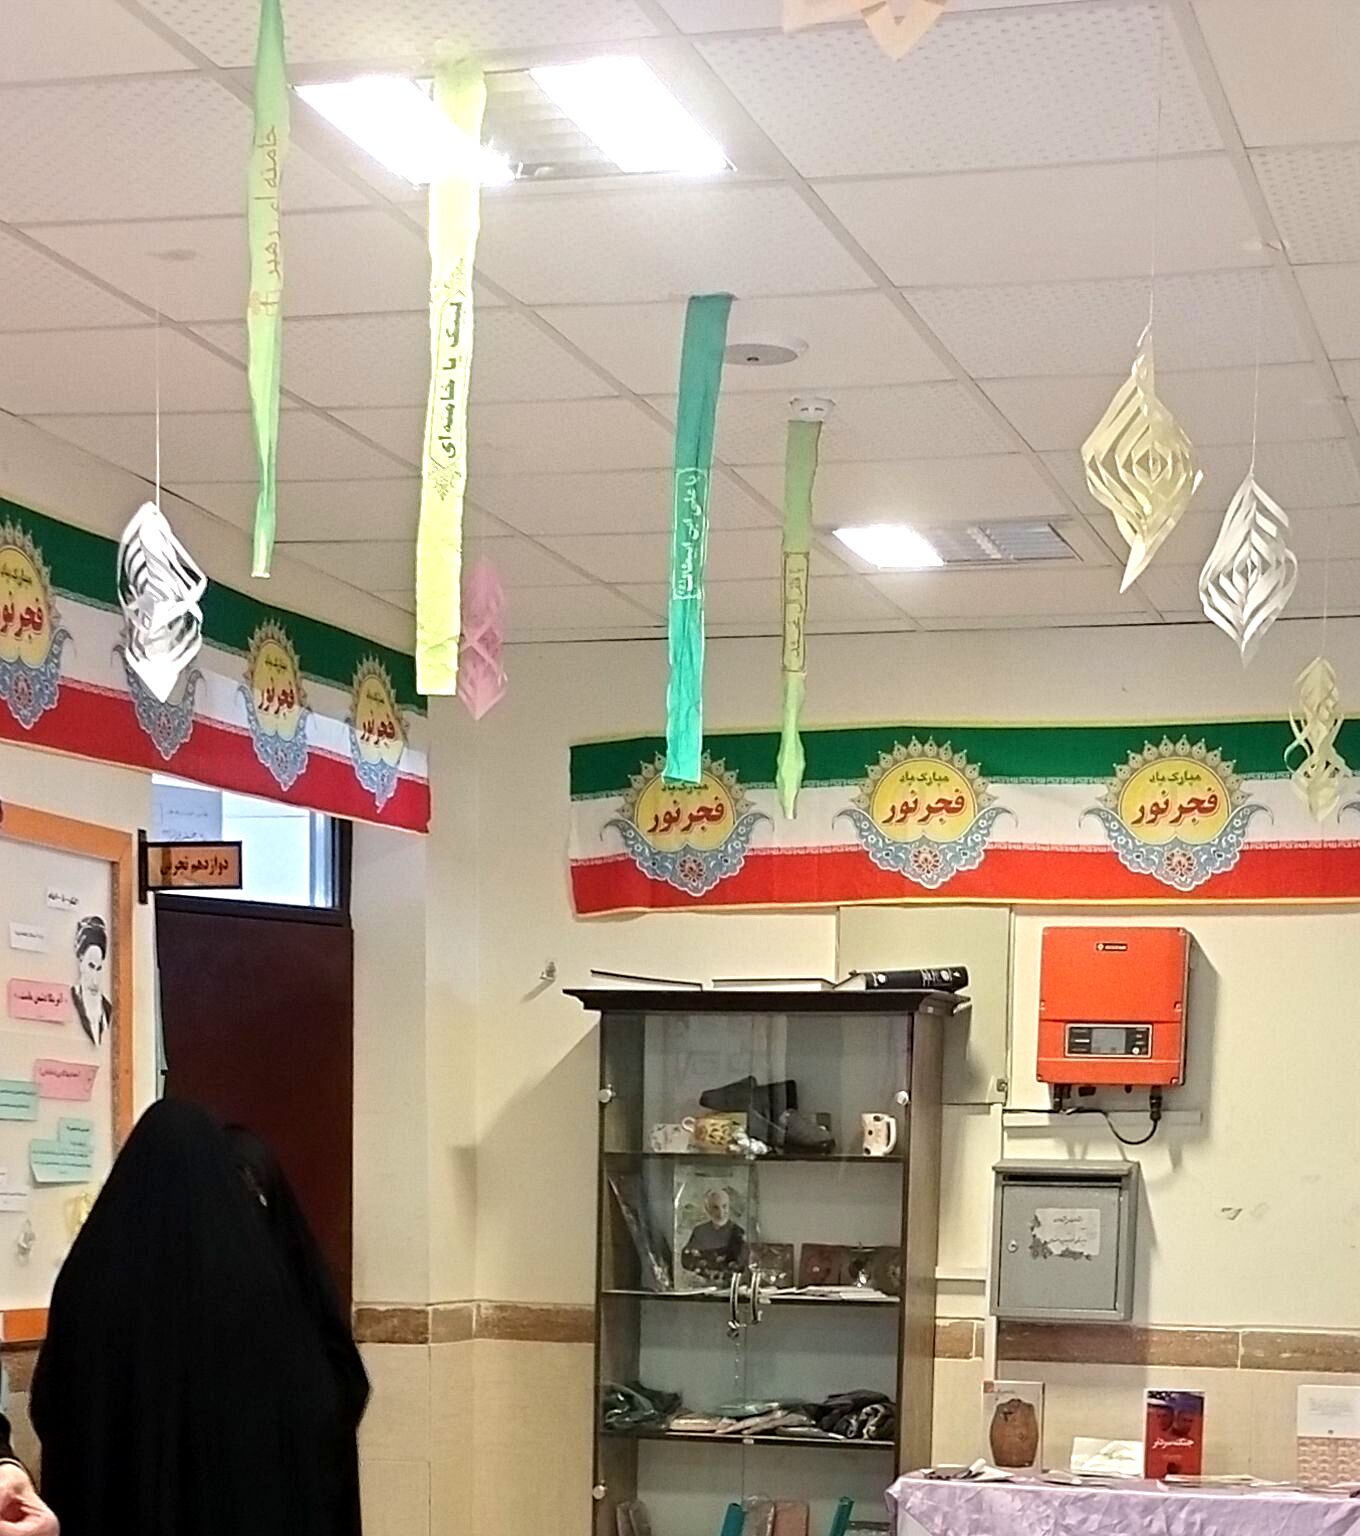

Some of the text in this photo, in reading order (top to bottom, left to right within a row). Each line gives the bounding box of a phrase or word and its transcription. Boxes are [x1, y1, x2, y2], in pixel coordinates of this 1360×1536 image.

[445, 301, 466, 348] لبیک
[14, 597, 44, 643] فجر
[898, 771, 950, 787] مبارک باد
[1148, 769, 1202, 786] مبارک باد
[647, 795, 725, 834] فجر نور
[883, 788, 966, 825] فجر نور
[1131, 786, 1219, 826] فجر نور
[190, 854, 229, 877] دوازدهم
